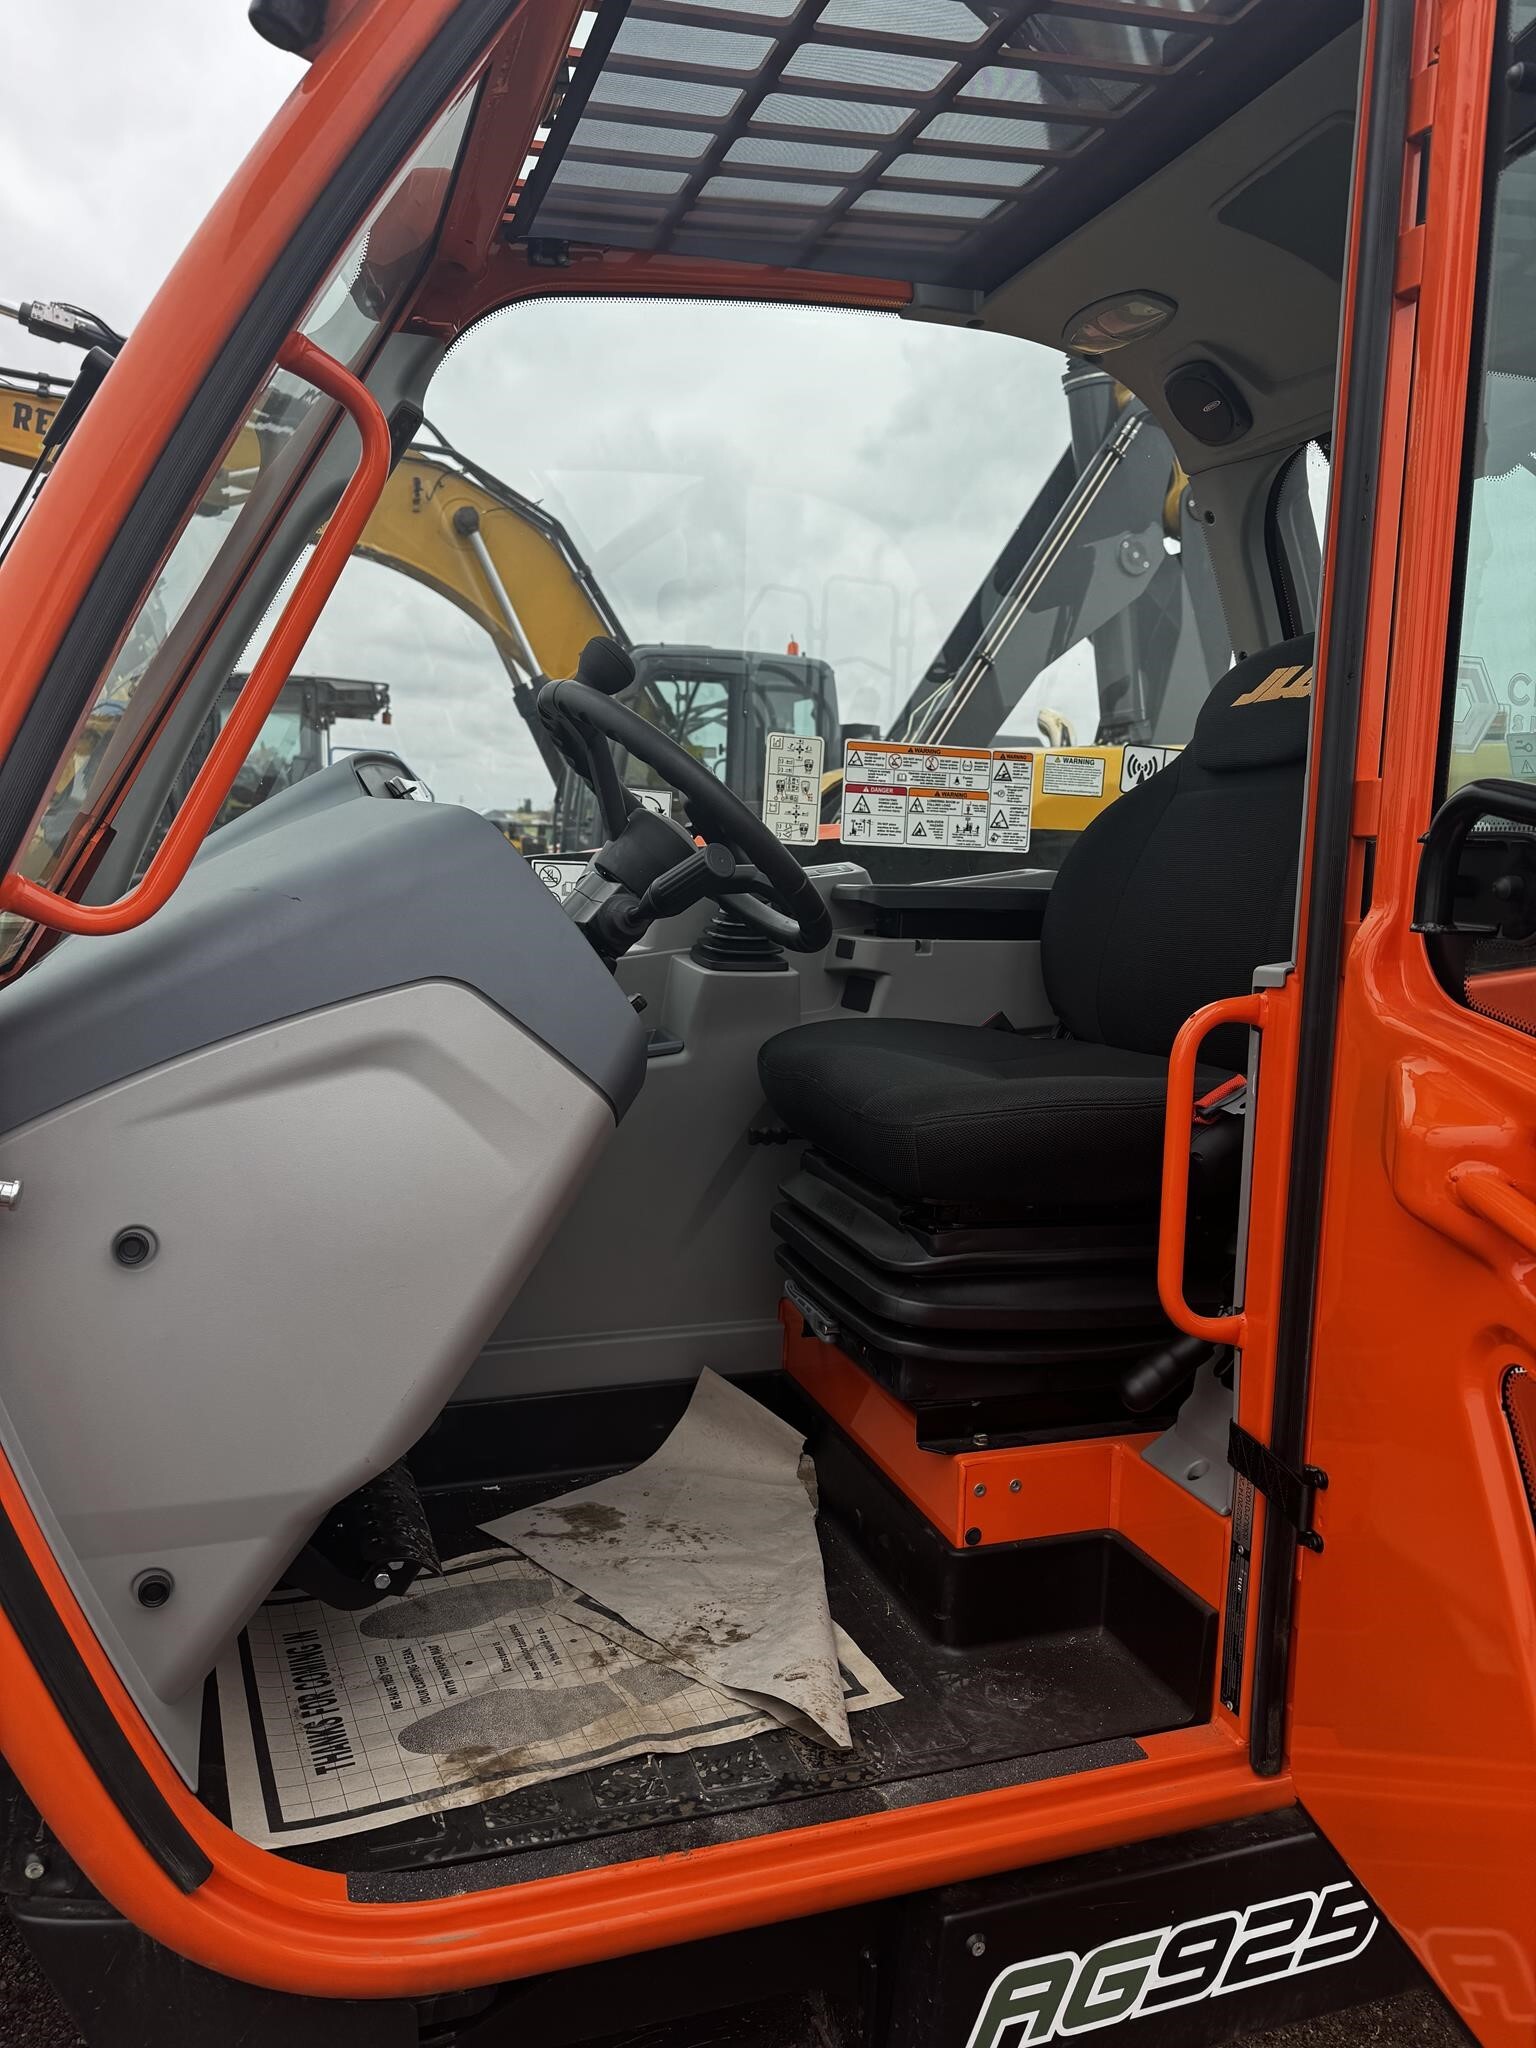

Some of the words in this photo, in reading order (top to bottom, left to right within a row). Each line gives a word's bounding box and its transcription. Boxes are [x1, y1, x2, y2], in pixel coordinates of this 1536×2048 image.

[914, 747, 941, 755] WARNING
[1063, 757, 1095, 766] WARNING
[282, 1629, 319, 1644] IN
[508, 1624, 522, 1638] person
[427, 1645, 443, 1656] MAT
[515, 1636, 533, 1662] important
[541, 1640, 555, 1654] world
[374, 1655, 389, 1667] KEEP
[432, 1655, 447, 1670] PAPER
[494, 1645, 511, 1669] customer
[549, 1652, 561, 1662] the
[286, 1643, 332, 1691] COMING
[379, 1666, 390, 1675] TO
[527, 1660, 539, 1672] most
[407, 1664, 427, 1689] CARPETING
[438, 1669, 452, 1681] THIS
[533, 1671, 544, 1680] the
[386, 1686, 400, 1701] HAVE
[443, 1680, 458, 1696] WITH
[298, 1689, 340, 1718] FOR
[417, 1688, 432, 1705] YOUR
[390, 1700, 403, 1711] WE
[302, 1716, 355, 1776] THANKS
[966, 1881, 1380, 2048] AG925
